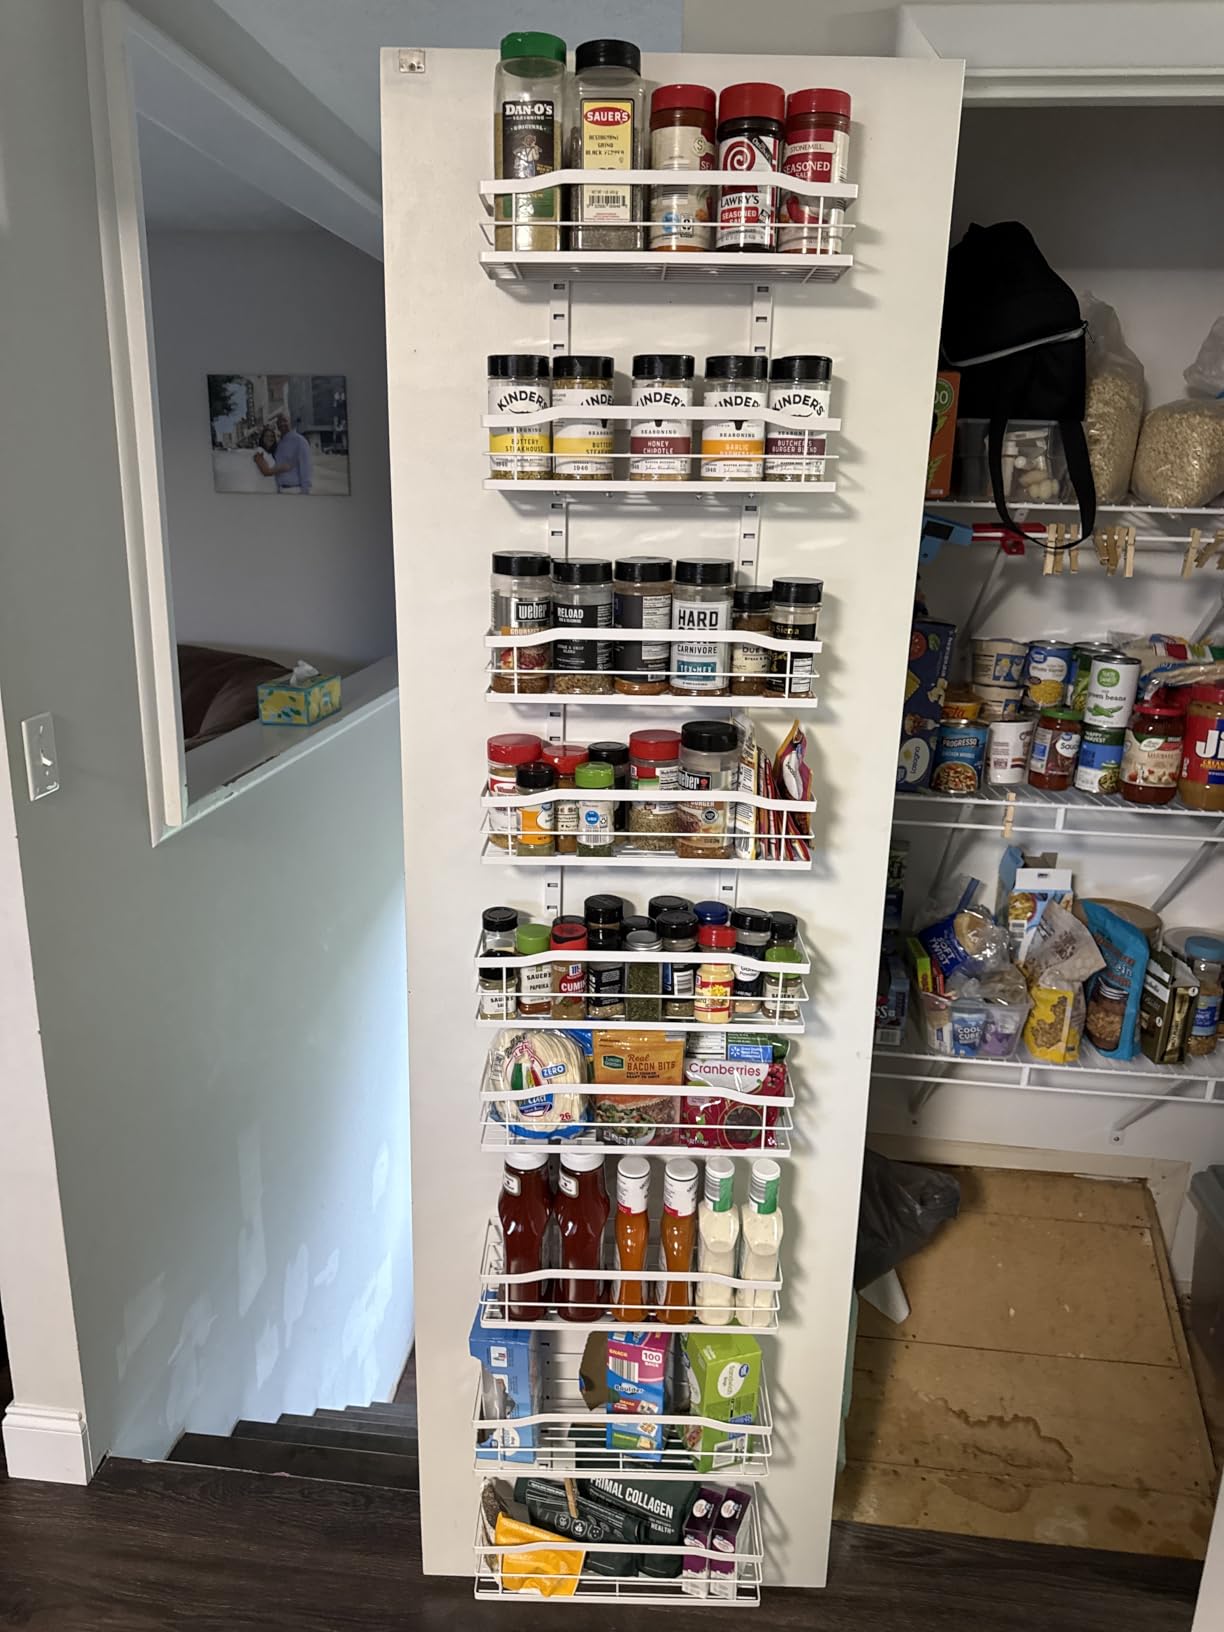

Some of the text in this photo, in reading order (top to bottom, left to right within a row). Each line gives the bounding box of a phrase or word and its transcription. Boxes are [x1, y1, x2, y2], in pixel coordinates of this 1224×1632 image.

[586, 111, 629, 121] SAUER'S
[783, 161, 830, 174] SEASONED
[518, 602, 548, 619] weber
[557, 607, 584, 618] RELOAD
[678, 609, 719, 627] HARD
[677, 644, 717, 654] CARNIVORE
[942, 737, 978, 748] PROGRESSO
[928, 937, 950, 966] TWIST
[937, 937, 956, 960] SOFT
[627, 1053, 650, 1062] Real
[542, 1065, 565, 1077] ZERO
[627, 1061, 676, 1072] BACON BITS
[689, 1062, 761, 1077] Cranberries
[559, 1112, 572, 1121] 26
[643, 1352, 661, 1362] 100
[590, 1478, 674, 1519] PRIMAL COLLAGEN
